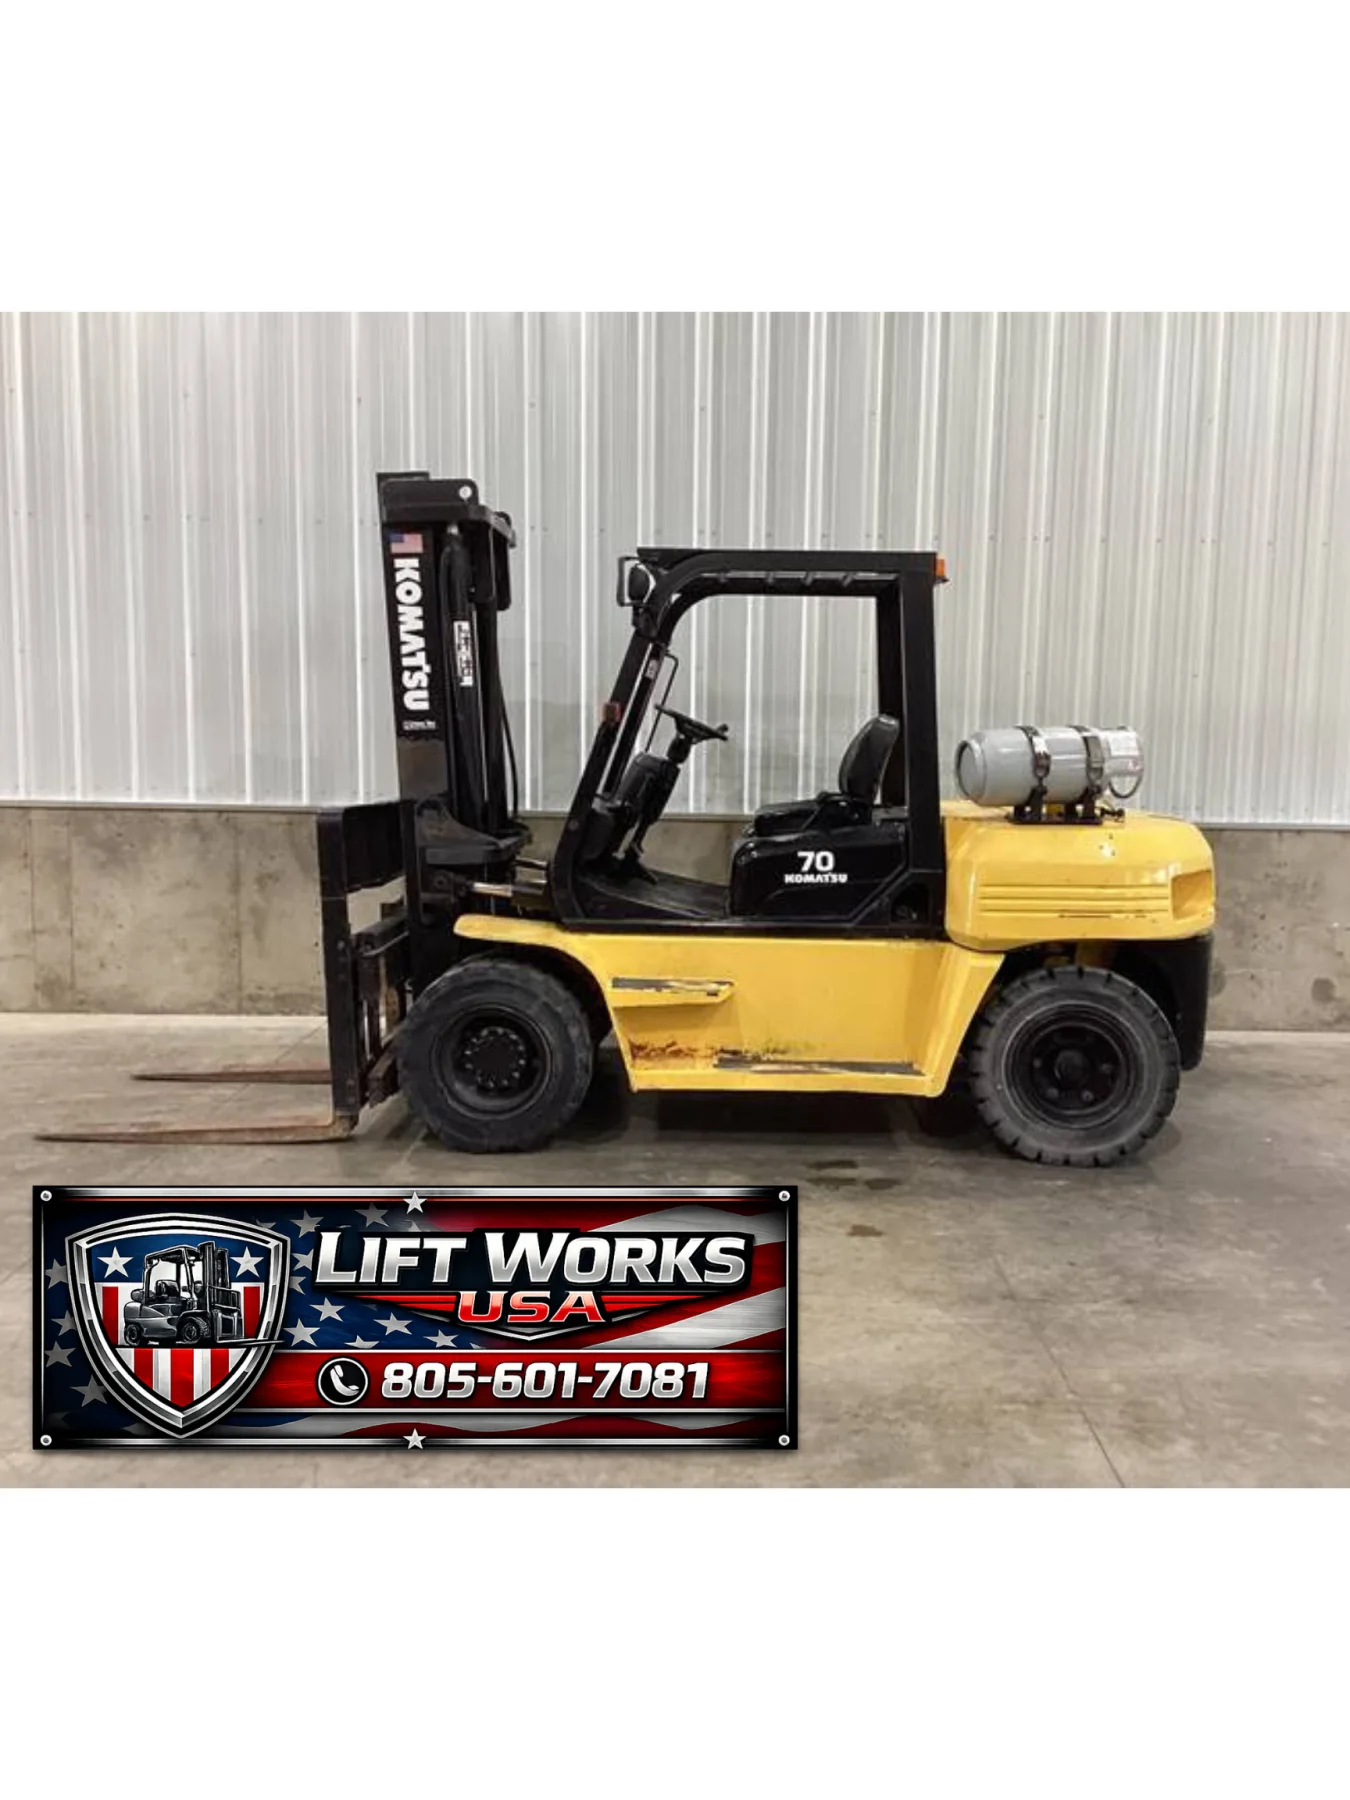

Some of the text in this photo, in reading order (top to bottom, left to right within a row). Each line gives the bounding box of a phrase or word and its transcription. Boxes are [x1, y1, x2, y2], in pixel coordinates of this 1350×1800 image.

[393, 558, 432, 711] KOMATSU
[797, 851, 834, 872] 70
[784, 872, 848, 884] KOMATSU
